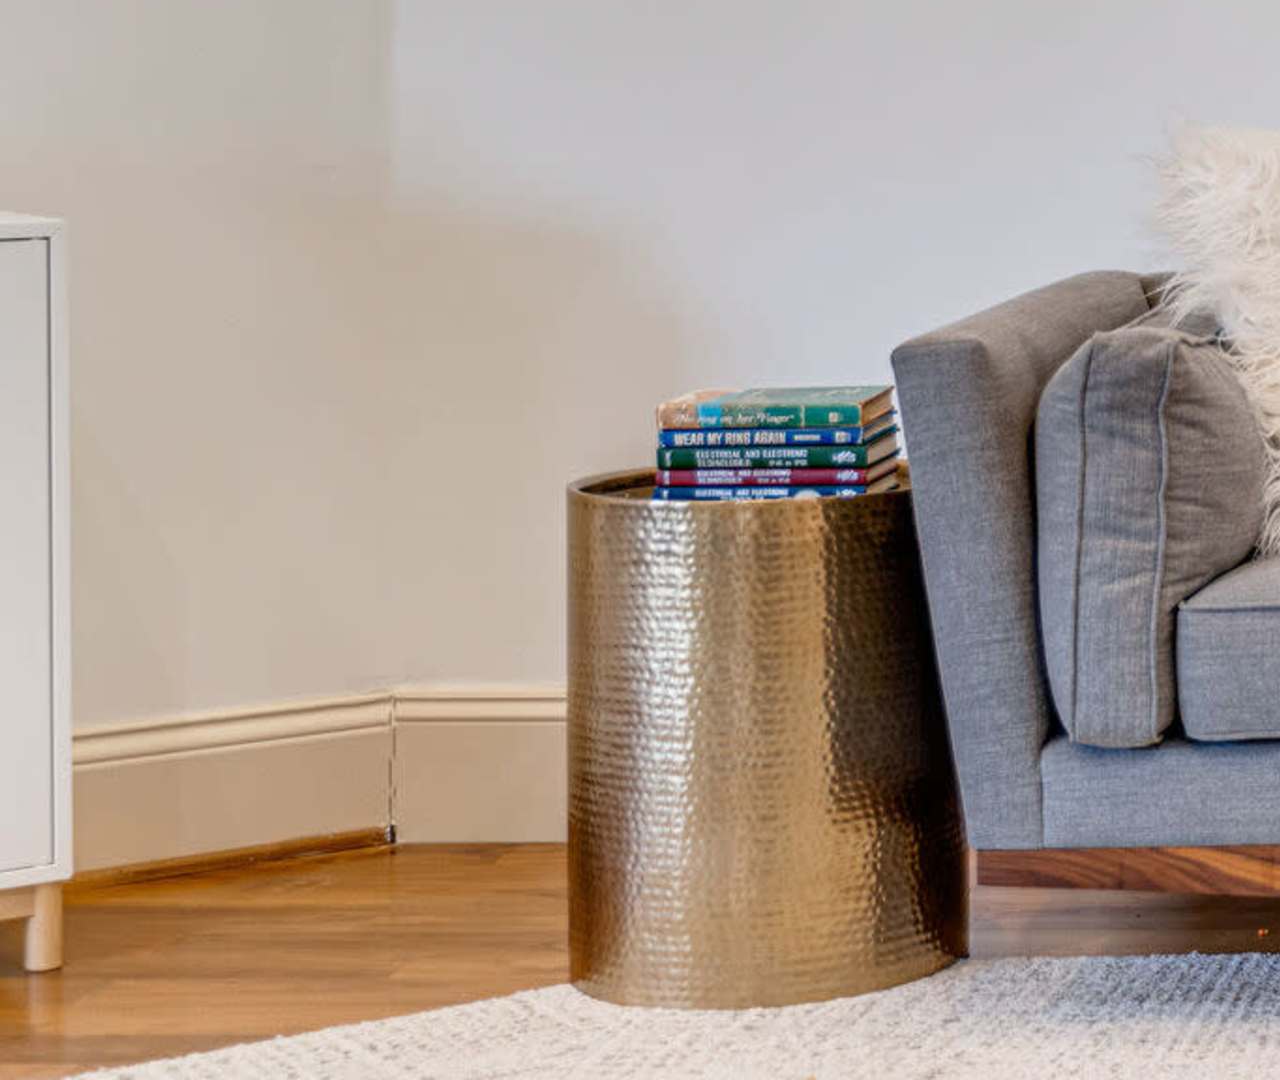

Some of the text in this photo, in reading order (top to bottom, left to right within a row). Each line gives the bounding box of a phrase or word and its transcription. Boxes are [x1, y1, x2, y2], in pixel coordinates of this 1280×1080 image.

[674, 431, 705, 446] WEAR
[707, 431, 723, 446] MY
[725, 431, 751, 445] RING
[753, 431, 786, 445] AGAIN
